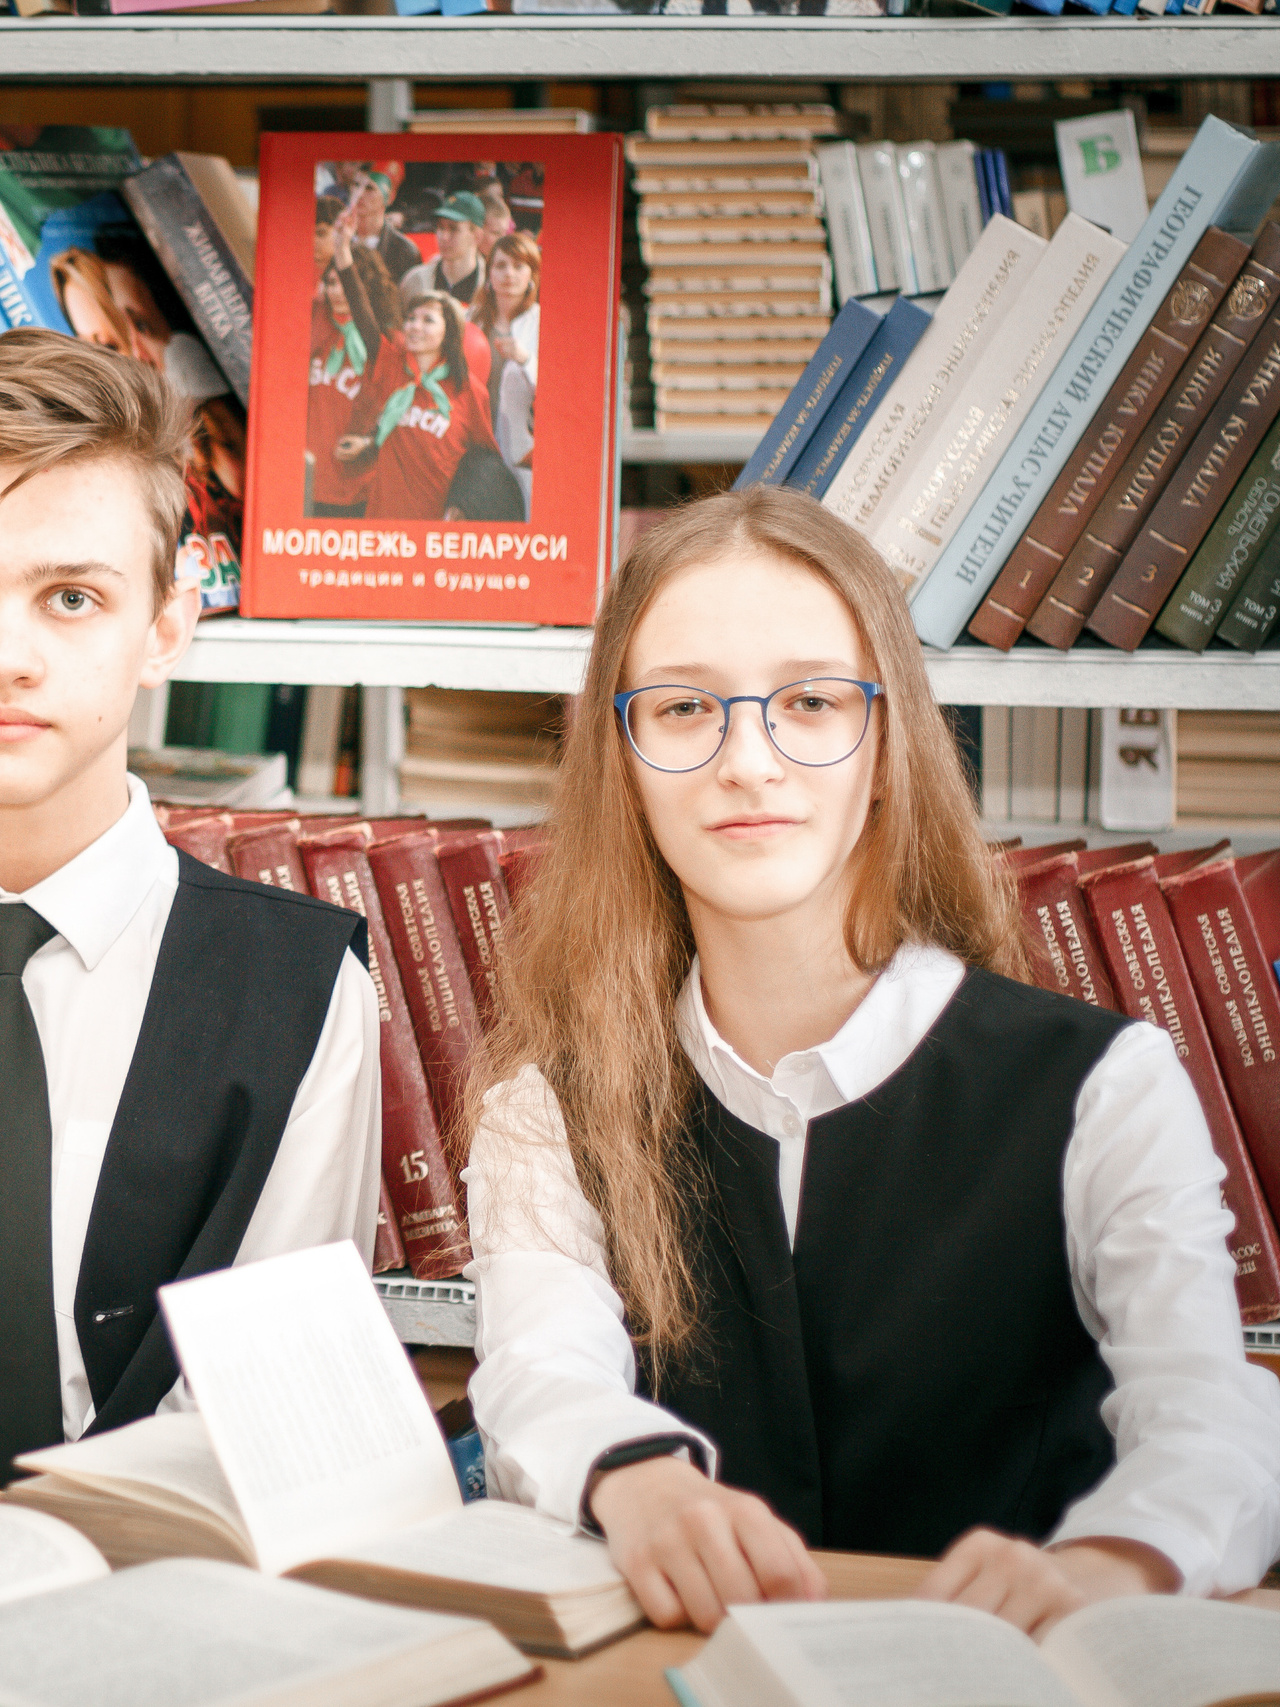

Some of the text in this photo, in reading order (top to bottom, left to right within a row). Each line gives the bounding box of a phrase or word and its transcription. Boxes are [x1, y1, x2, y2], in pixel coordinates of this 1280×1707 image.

[1077, 134, 1122, 177] Б
[181, 218, 232, 287] ЖИВАЯ
[951, 183, 1204, 588] ГЕОГРАФИЧЕСКИЙ АТЛАС УЧИТЕЛЯ
[1055, 348, 1169, 521] ЯНКА КУПАЛА
[1114, 344, 1229, 517] ЯНКА КУПАЛА
[1179, 412, 1250, 513] КУПАЛА
[262, 528, 568, 561] МОЛОДЕЖЬ БЕЛАРУСИ
[1224, 473, 1269, 540] ОБЛАСТЬ
[298, 568, 531, 592] традиции и будущее
[1208, 595, 1224, 615] 3
[392, 881, 445, 1033] БОЛЬШАЯ СОВЕТСКАЯ
[410, 877, 462, 1028] ЭНЦИКЛОПЕДИЯ
[460, 884, 493, 965] СОВЕТСКАЯ
[1034, 903, 1073, 989] СОВЕТСКАЯ
[1109, 907, 1148, 992] СОВЕТСКАЯ
[1128, 900, 1192, 1060] ЭНЦИКЛОПЕДИЯ
[1195, 910, 1257, 1068] БОЛЬШАЯ СОВЕТСКАЯ
[1215, 904, 1277, 1063] ЭНЦИКЛОПЕДИЯ
[398, 1148, 430, 1185] 15
